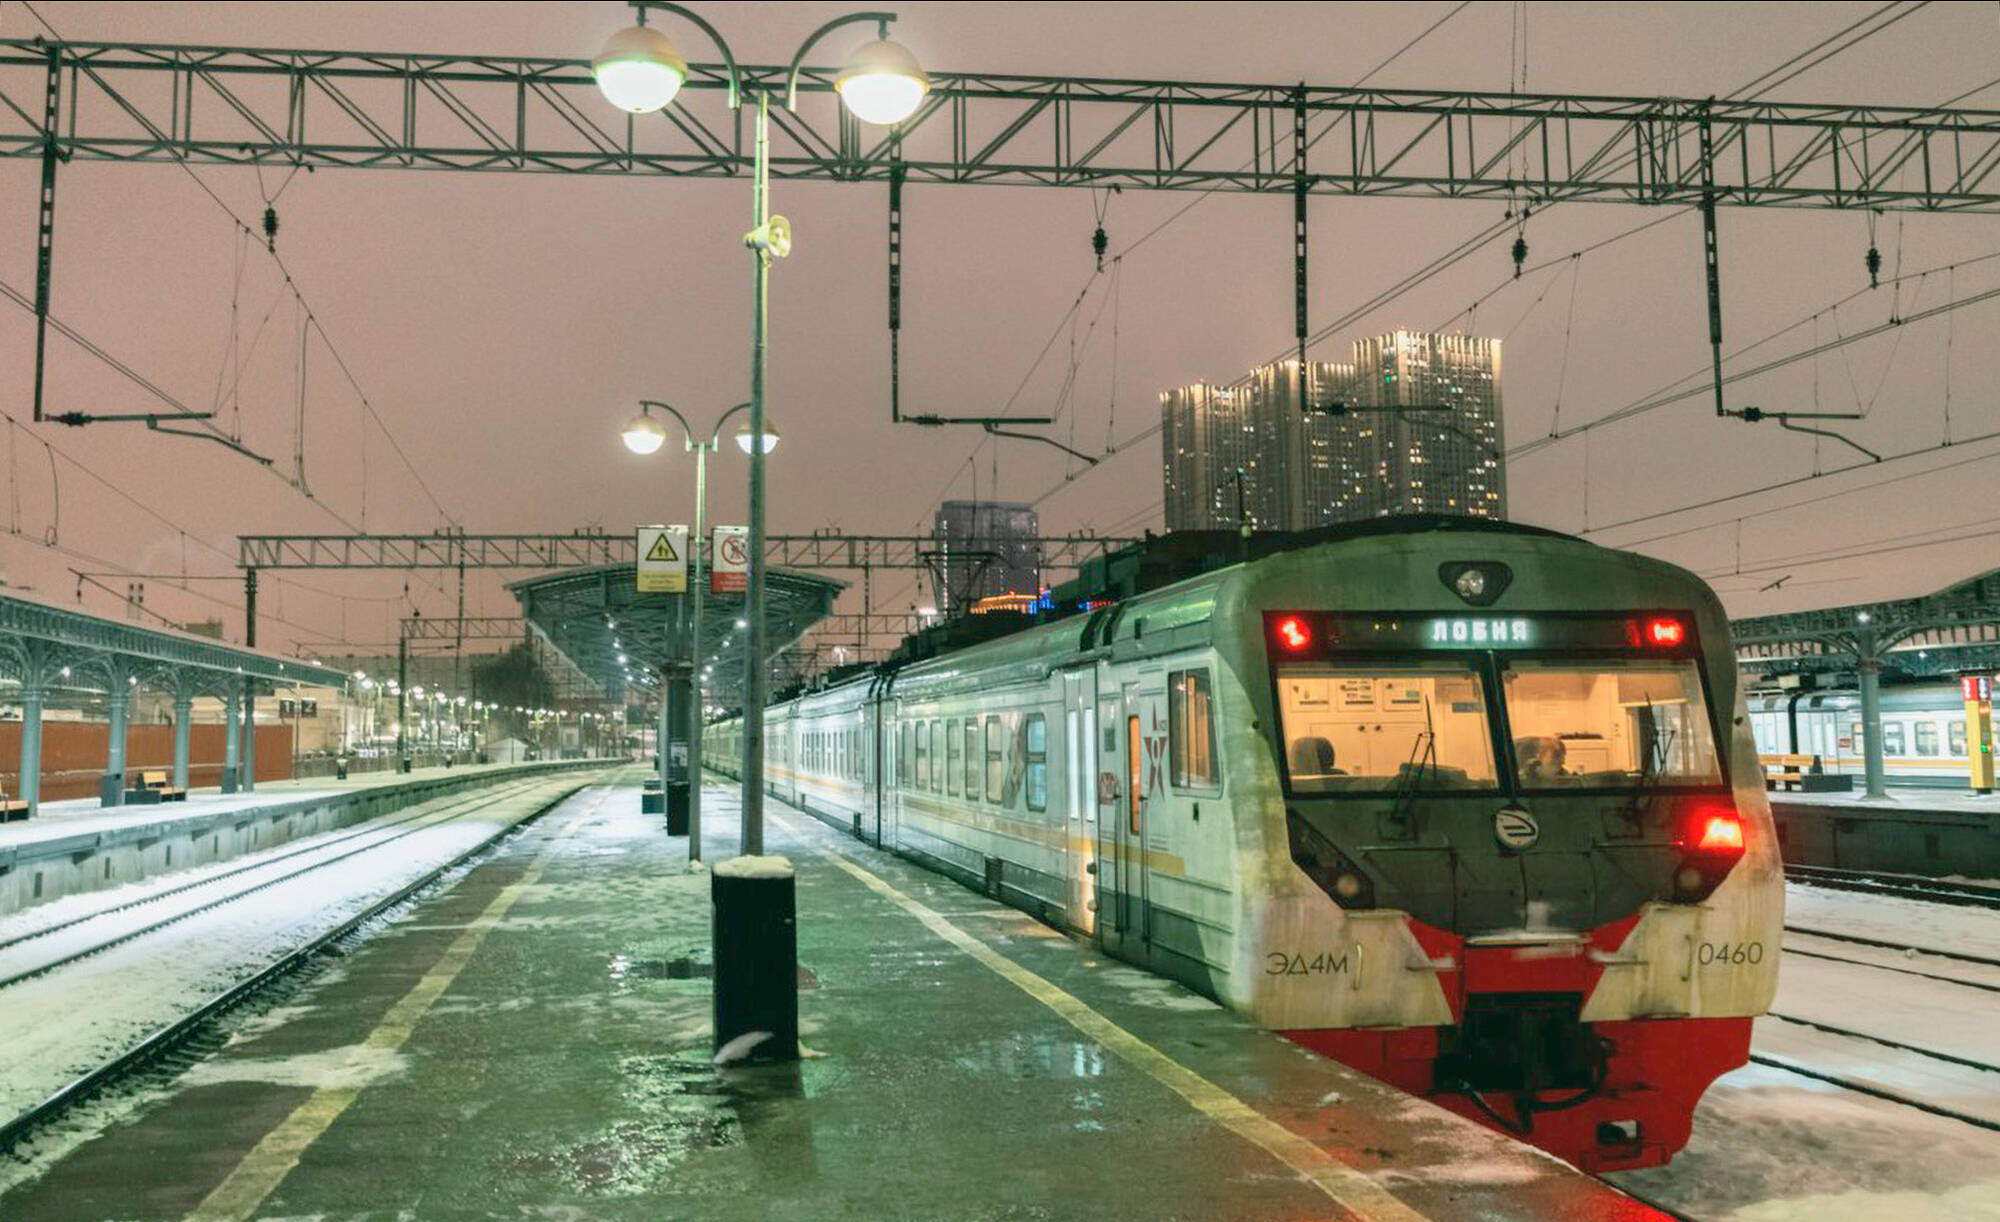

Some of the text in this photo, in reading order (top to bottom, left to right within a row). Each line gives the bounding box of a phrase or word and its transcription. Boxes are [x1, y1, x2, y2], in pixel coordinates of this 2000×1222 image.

[1433, 619, 1527, 641] ЛОБНЯ
[1265, 952, 1348, 976] ЭД4М
[1698, 942, 1763, 965] 0460
